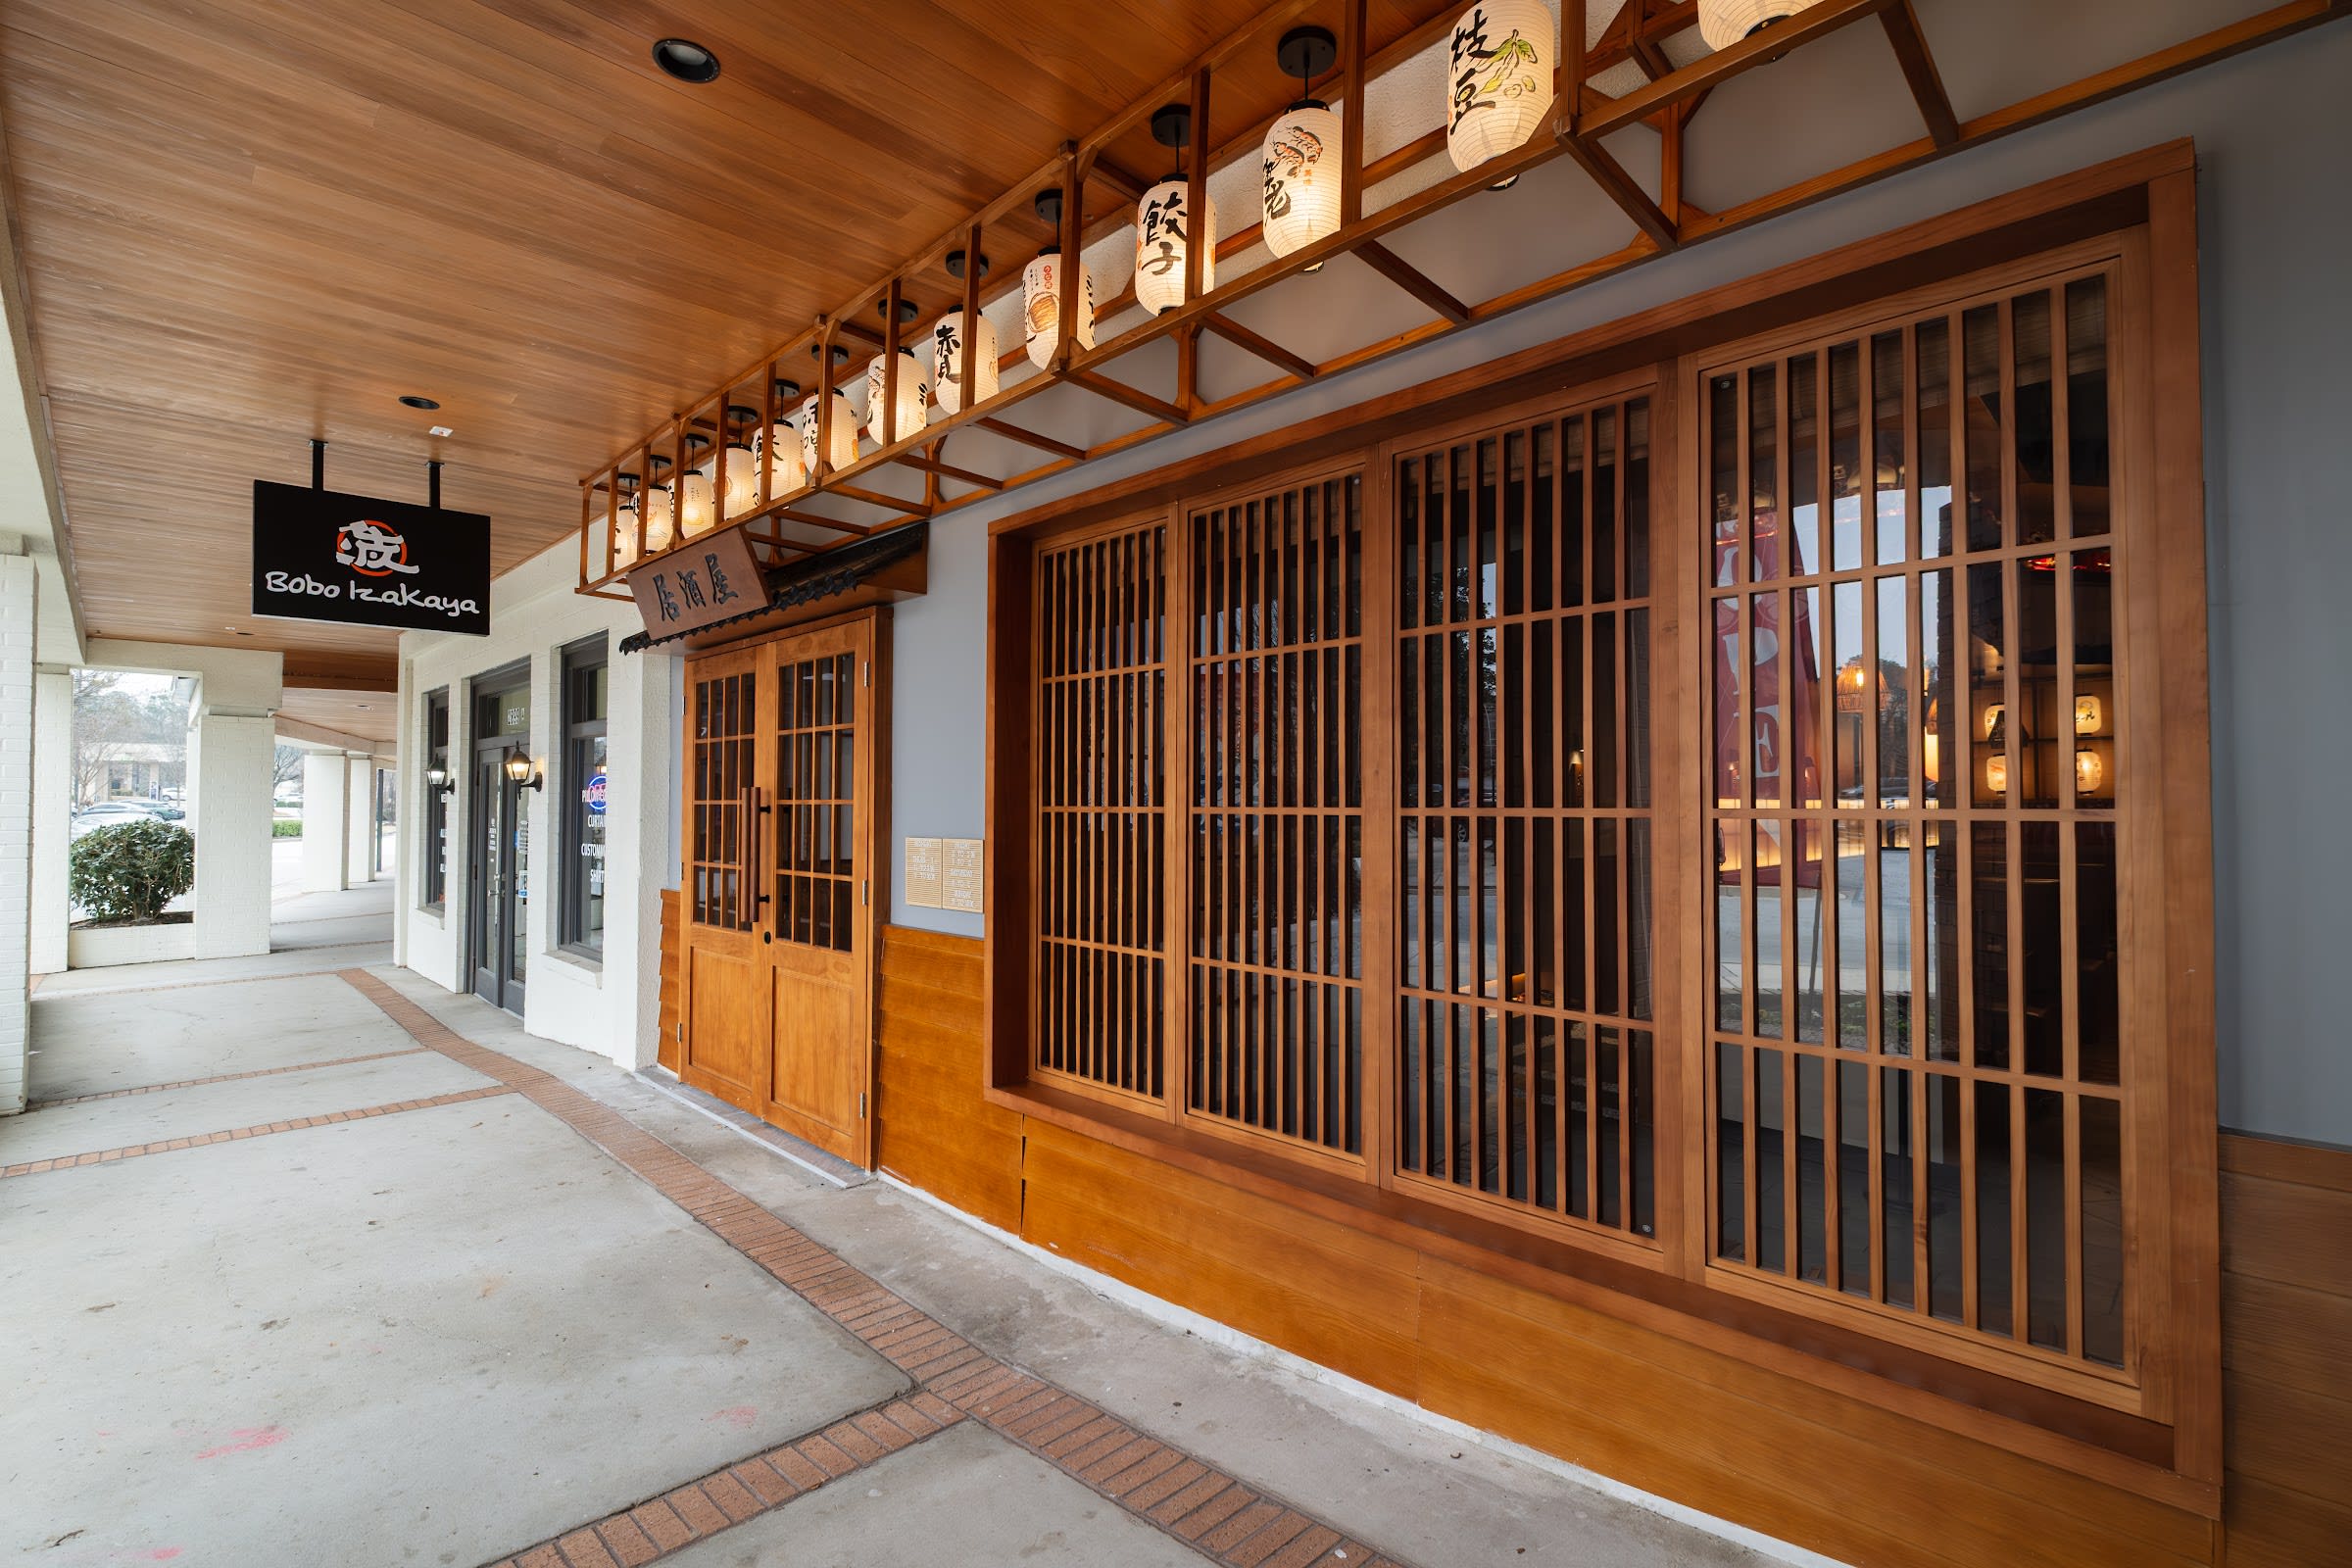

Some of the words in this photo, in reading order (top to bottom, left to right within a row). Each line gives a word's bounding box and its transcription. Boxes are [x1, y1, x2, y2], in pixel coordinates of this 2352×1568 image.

[266, 570, 341, 599] Bobo
[349, 580, 480, 617] Izakaya
[1717, 546, 1781, 849] OPE
